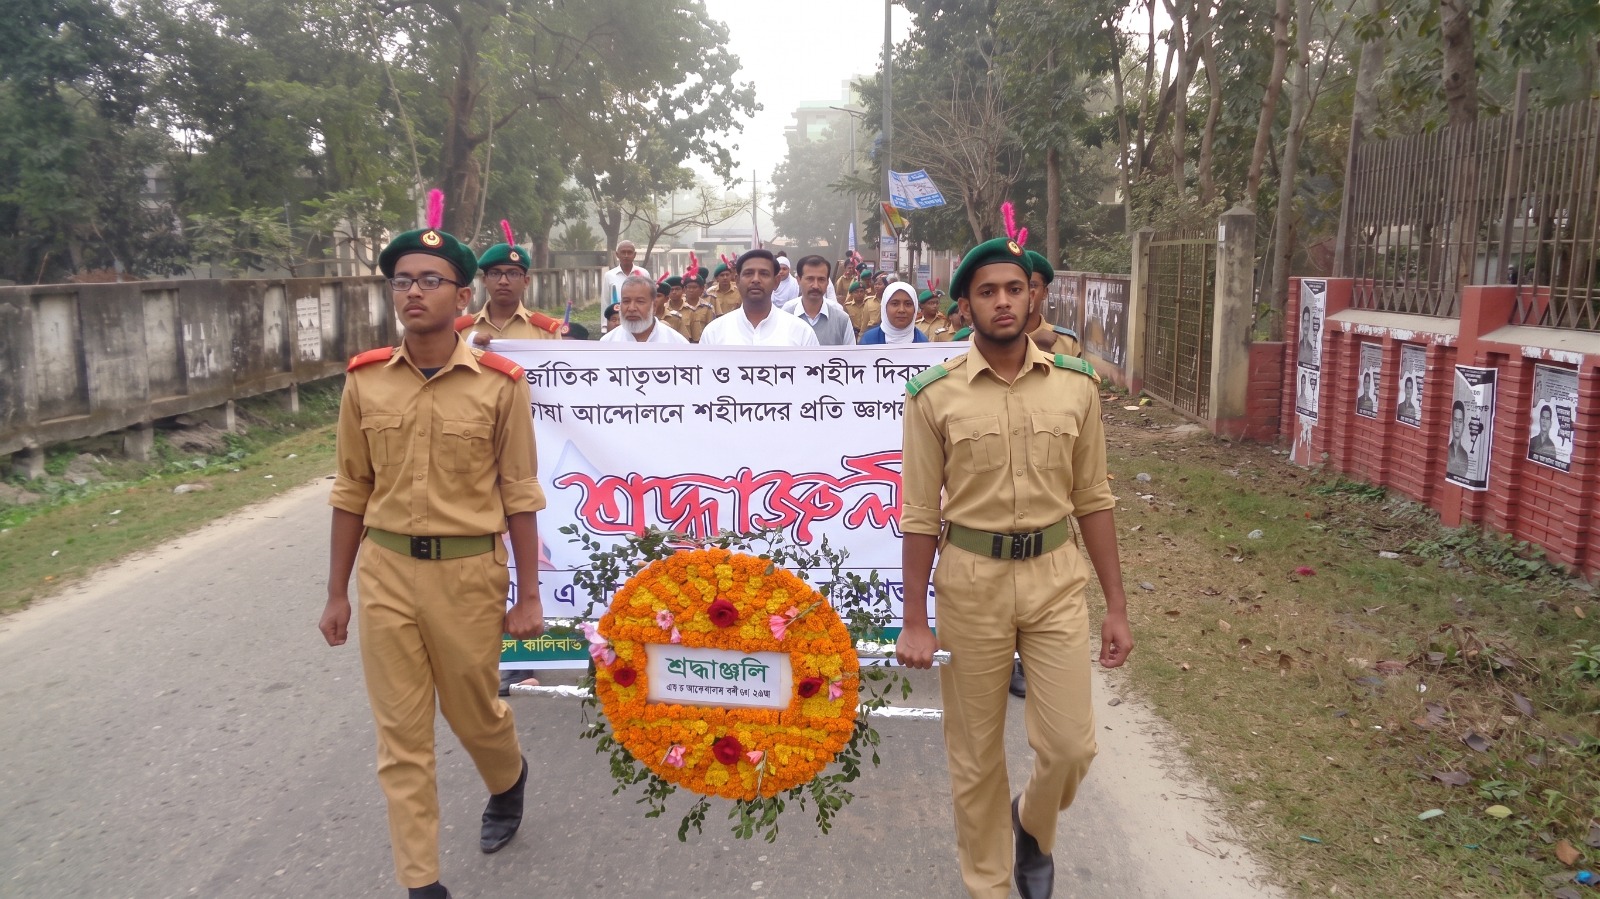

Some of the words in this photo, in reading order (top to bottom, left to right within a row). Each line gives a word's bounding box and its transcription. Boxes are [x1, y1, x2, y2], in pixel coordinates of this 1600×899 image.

[524, 360, 600, 388] র্জাতিক
[606, 365, 703, 396] মাতৃভাষা
[712, 366, 731, 385] ও
[738, 364, 796, 386] মহান
[804, 358, 866, 385] শহীদ
[531, 401, 564, 424] াষা
[570, 403, 685, 425] আন্দোলনে
[692, 395, 792, 424] শহীদদের
[800, 395, 845, 422] প্রতি
[664, 656, 770, 683] শ্রদ্ধাঞ্জলি
